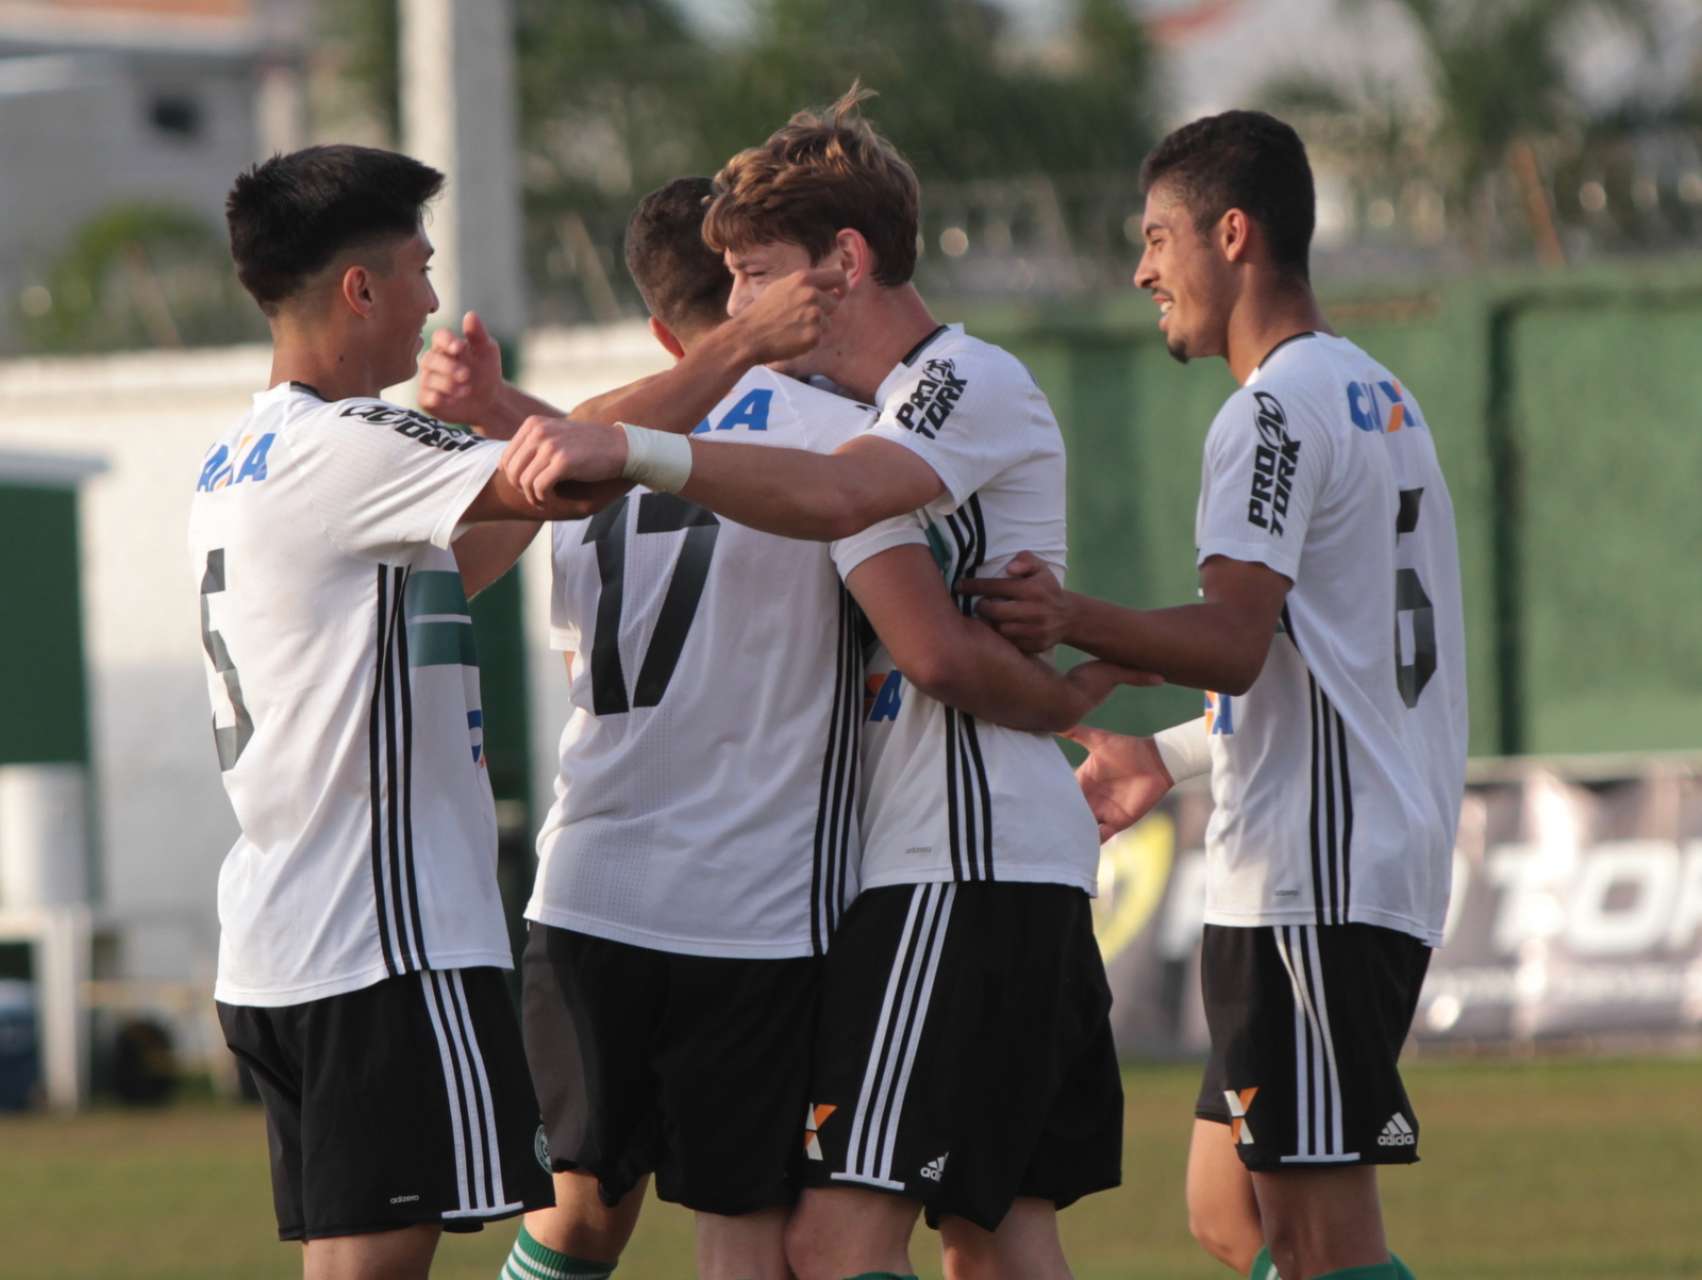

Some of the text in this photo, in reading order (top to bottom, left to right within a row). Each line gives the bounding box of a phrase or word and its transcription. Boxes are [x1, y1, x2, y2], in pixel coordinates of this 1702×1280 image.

[896, 379, 940, 431] PRO
[914, 371, 968, 440] TORK
[1248, 445, 1277, 529] PRO
[1269, 430, 1302, 538] TORK
[582, 491, 720, 716] 17
